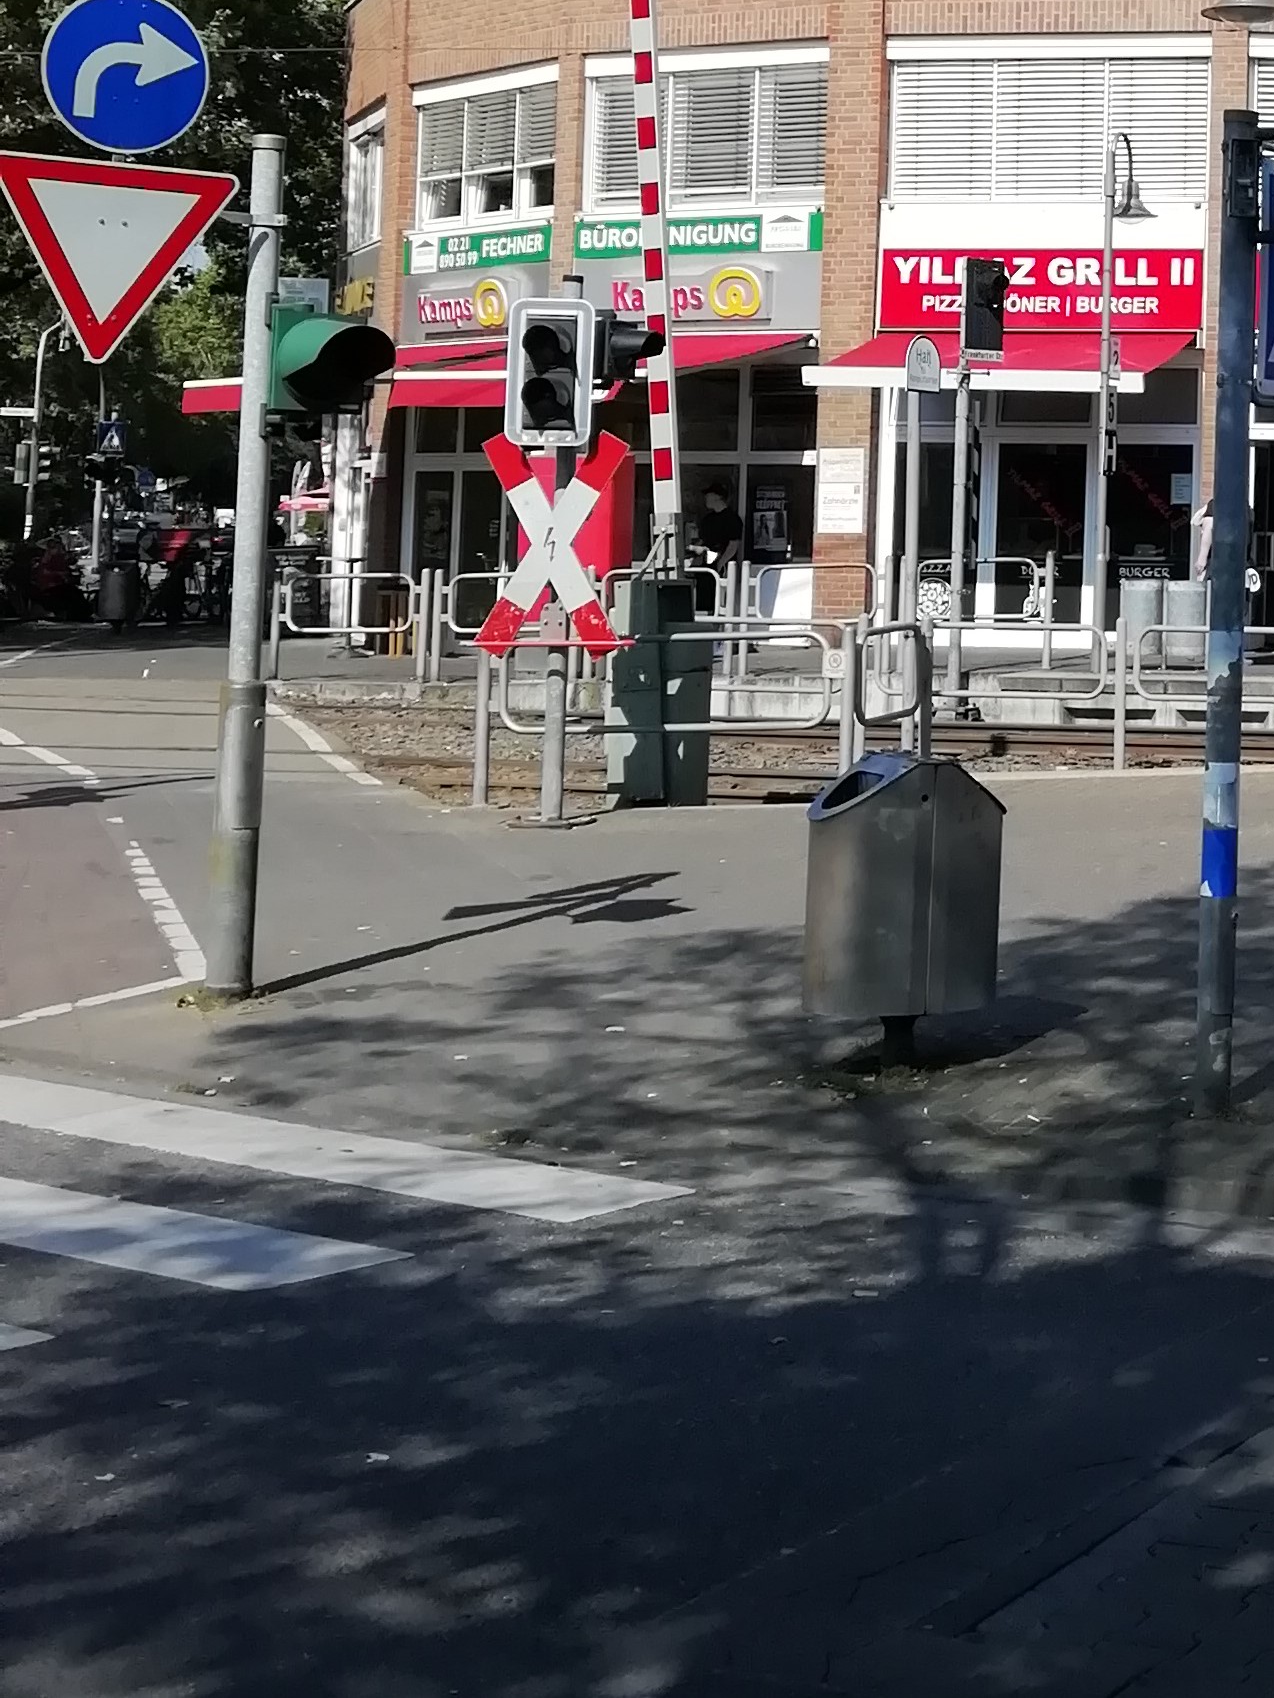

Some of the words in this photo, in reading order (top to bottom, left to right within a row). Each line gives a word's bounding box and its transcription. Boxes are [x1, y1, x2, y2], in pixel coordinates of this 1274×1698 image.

[482, 233, 543, 258] FECHNER
[579, 220, 757, 249] BÜRONIGUNG
[893, 257, 1036, 285] YILZ
[1047, 257, 1159, 286] GRLL
[1170, 258, 1195, 285] II
[417, 293, 472, 328] Kamps
[612, 281, 704, 318] Kaps
[1003, 293, 1061, 313] ÖNER
[1075, 296, 1159, 314] BURGER
[1119, 566, 1170, 578] BURGER
